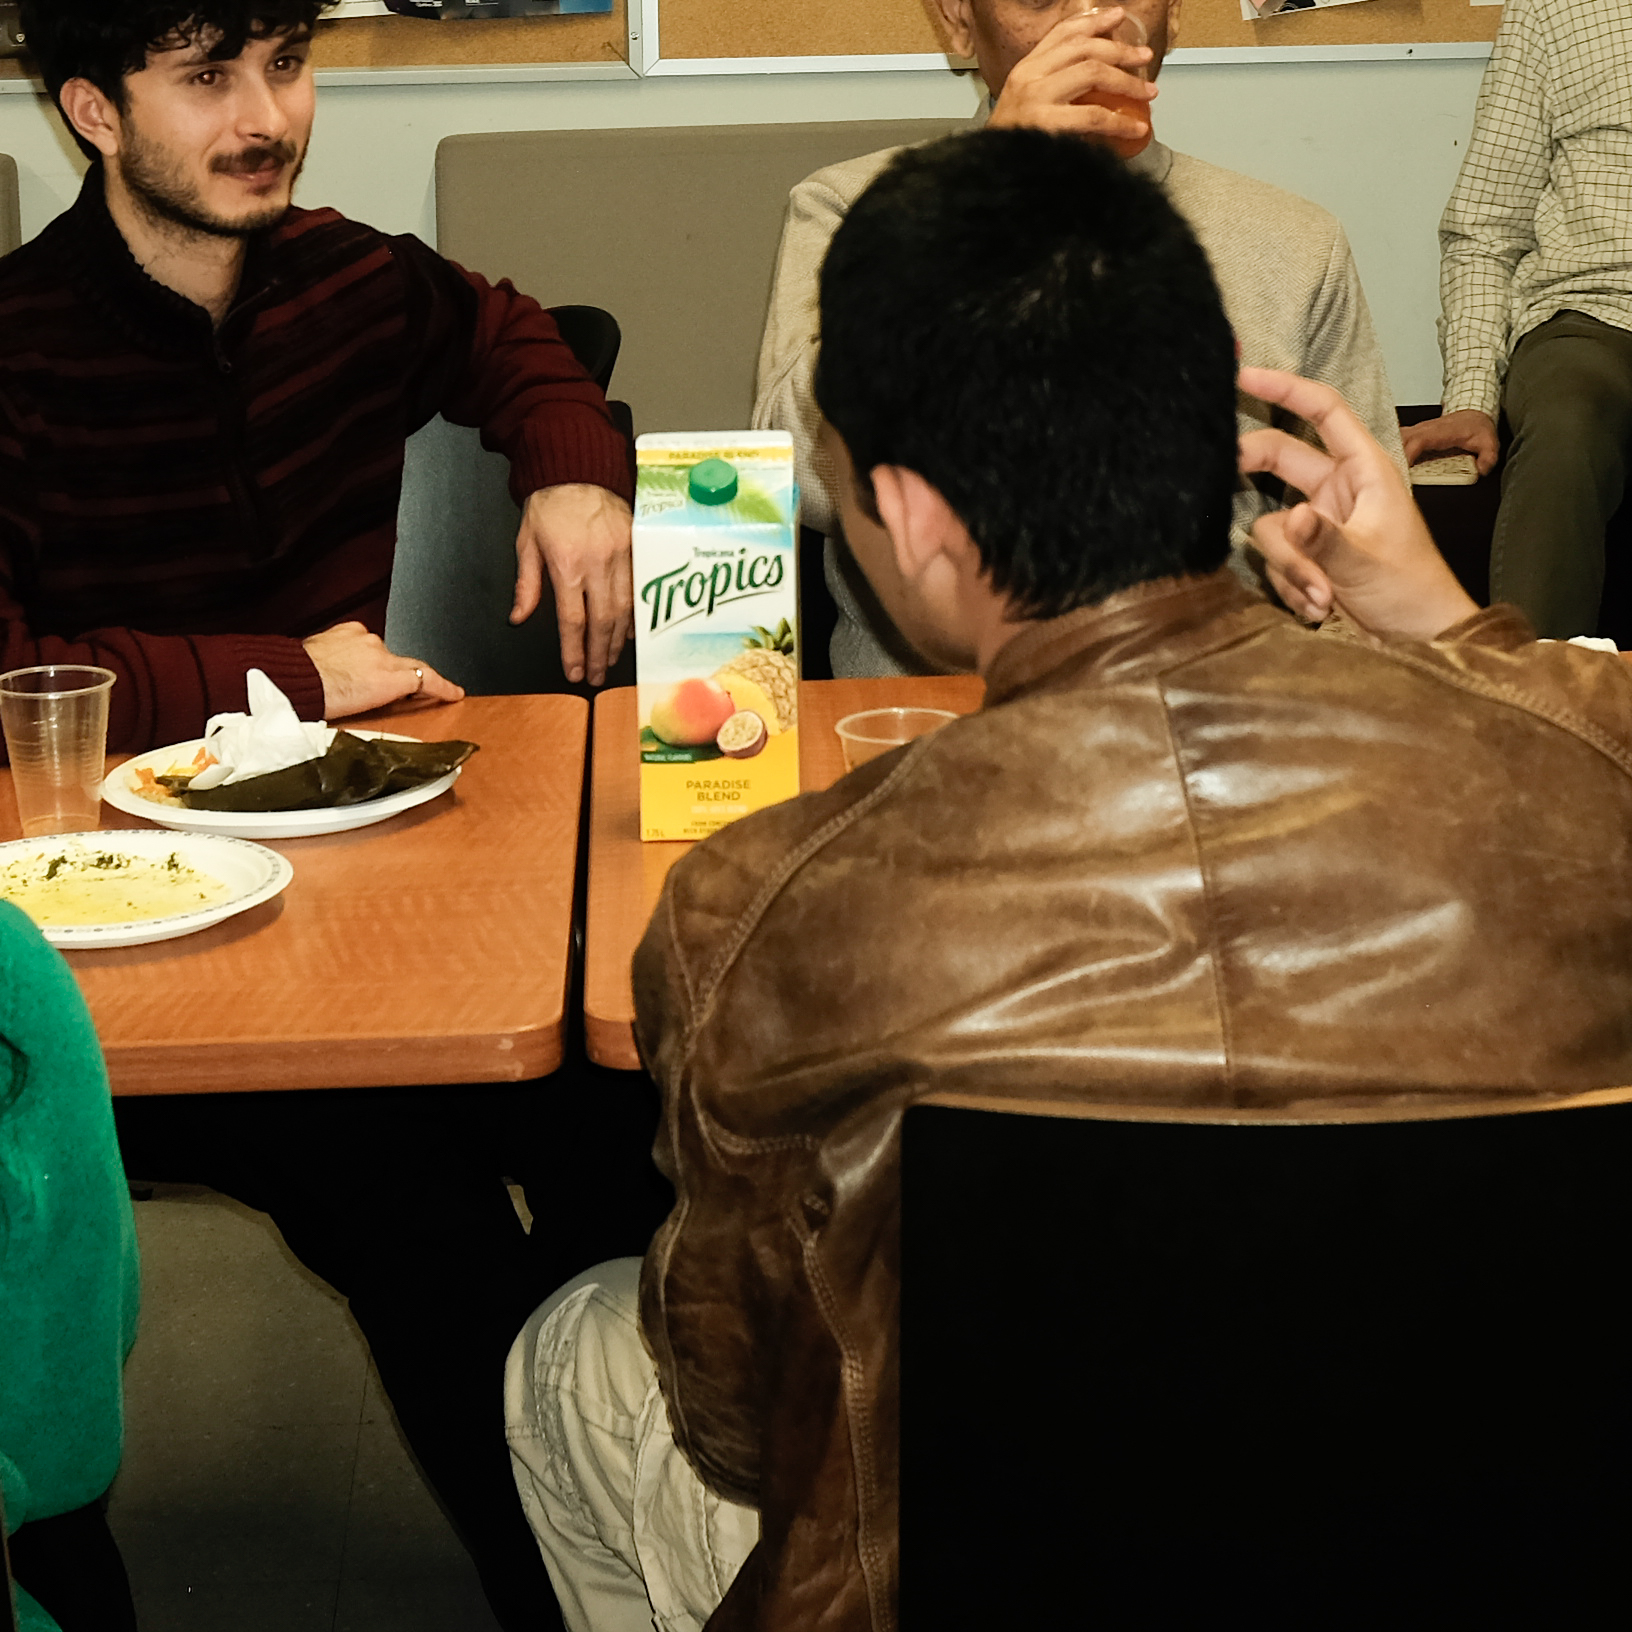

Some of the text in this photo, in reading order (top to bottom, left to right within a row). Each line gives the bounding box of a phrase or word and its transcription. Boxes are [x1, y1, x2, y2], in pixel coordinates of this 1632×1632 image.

[693, 547, 735, 558] Tropicana
[642, 548, 783, 631] Tropics
[686, 780, 751, 789] PARADISE
[697, 792, 740, 801] BLEND
